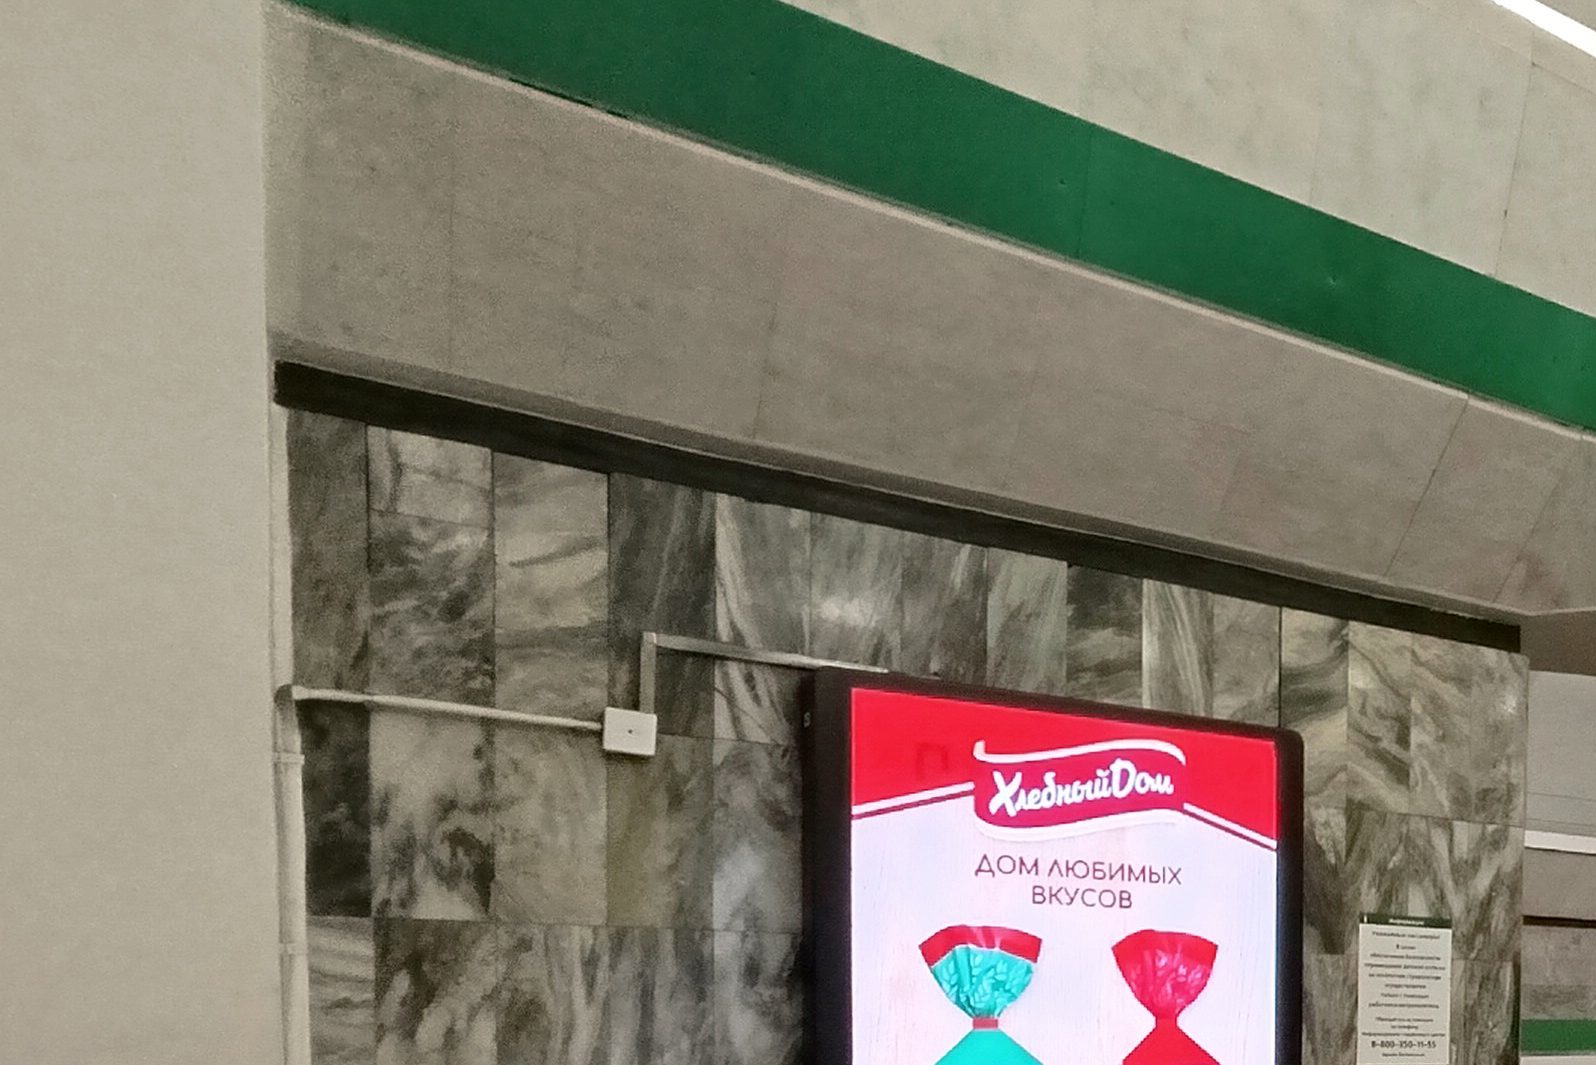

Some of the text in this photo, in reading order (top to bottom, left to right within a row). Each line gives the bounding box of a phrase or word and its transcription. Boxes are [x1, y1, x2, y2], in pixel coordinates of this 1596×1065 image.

[989, 757, 1173, 817] Хлебный Дом
[975, 853, 1182, 885] ДОМ ЛЮБИМЫХ
[1031, 885, 1133, 909] ВКУСОВ
